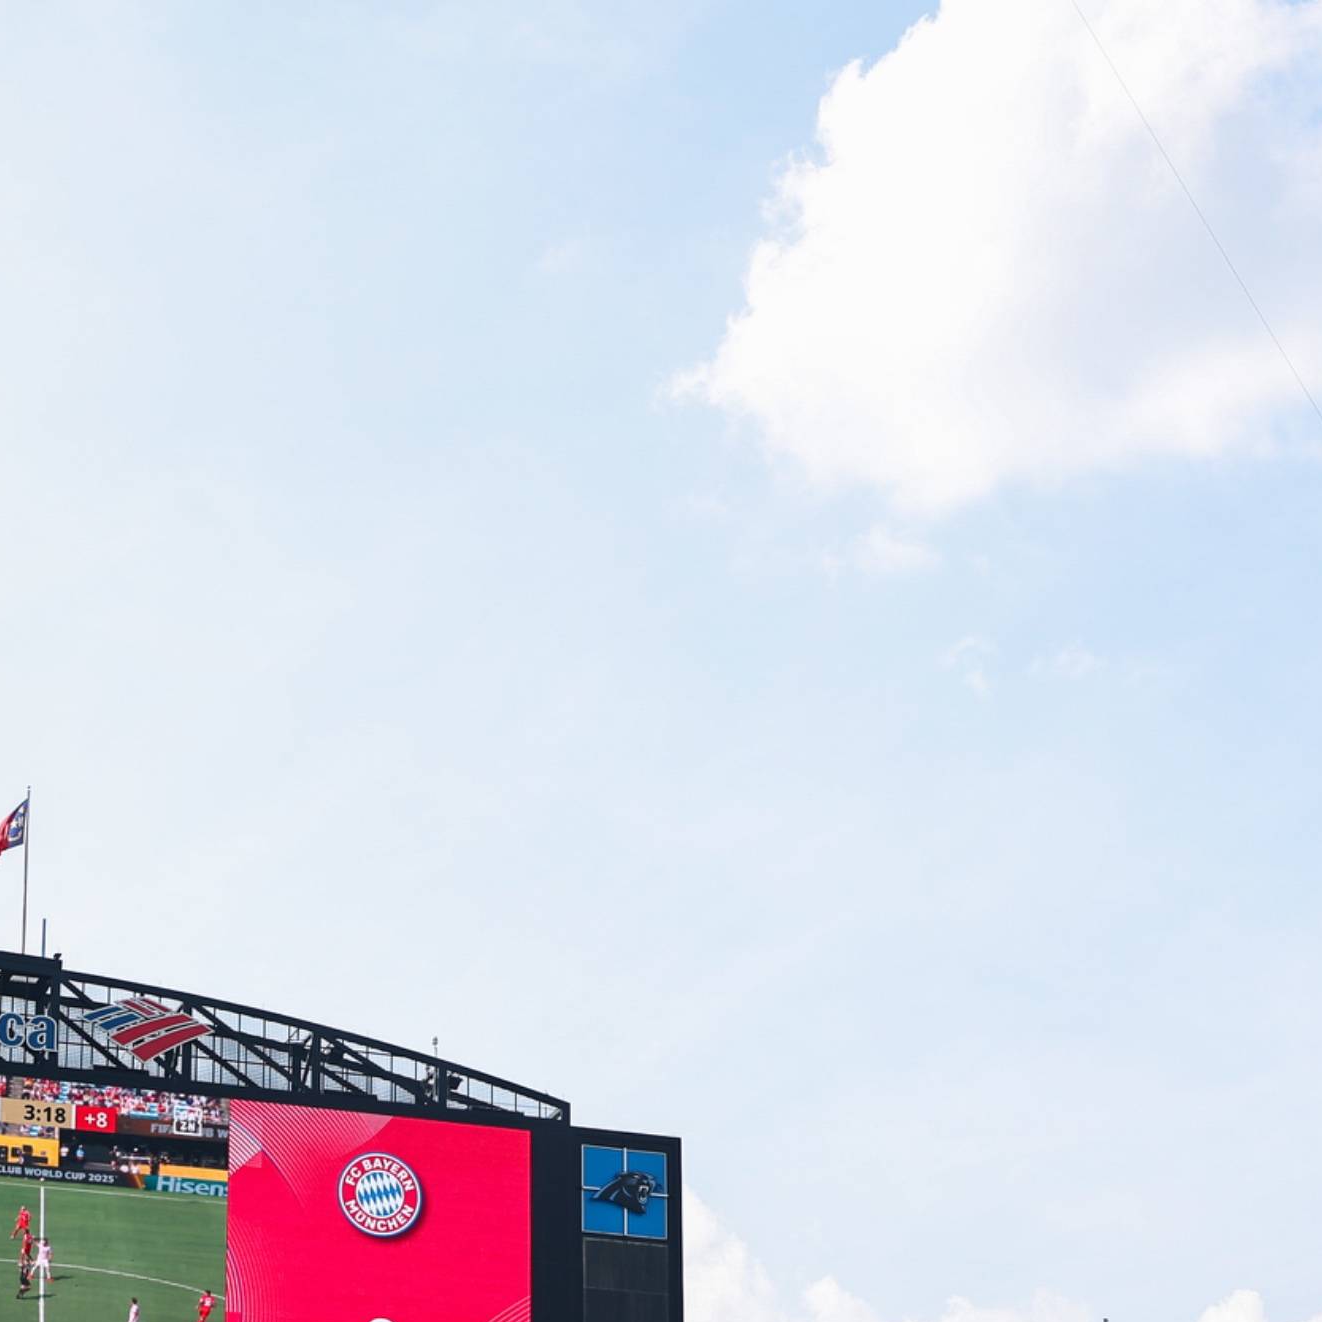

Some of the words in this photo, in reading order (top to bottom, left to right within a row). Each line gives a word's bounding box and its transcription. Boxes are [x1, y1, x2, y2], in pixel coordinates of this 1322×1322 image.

[23, 1105, 66, 1123] 3:18
[84, 1112, 108, 1128] +8
[25, 1167, 61, 1179] WORLD
[64, 1170, 86, 1181] CUP
[345, 1166, 362, 1187] FC
[362, 1158, 414, 1192] BAYERN
